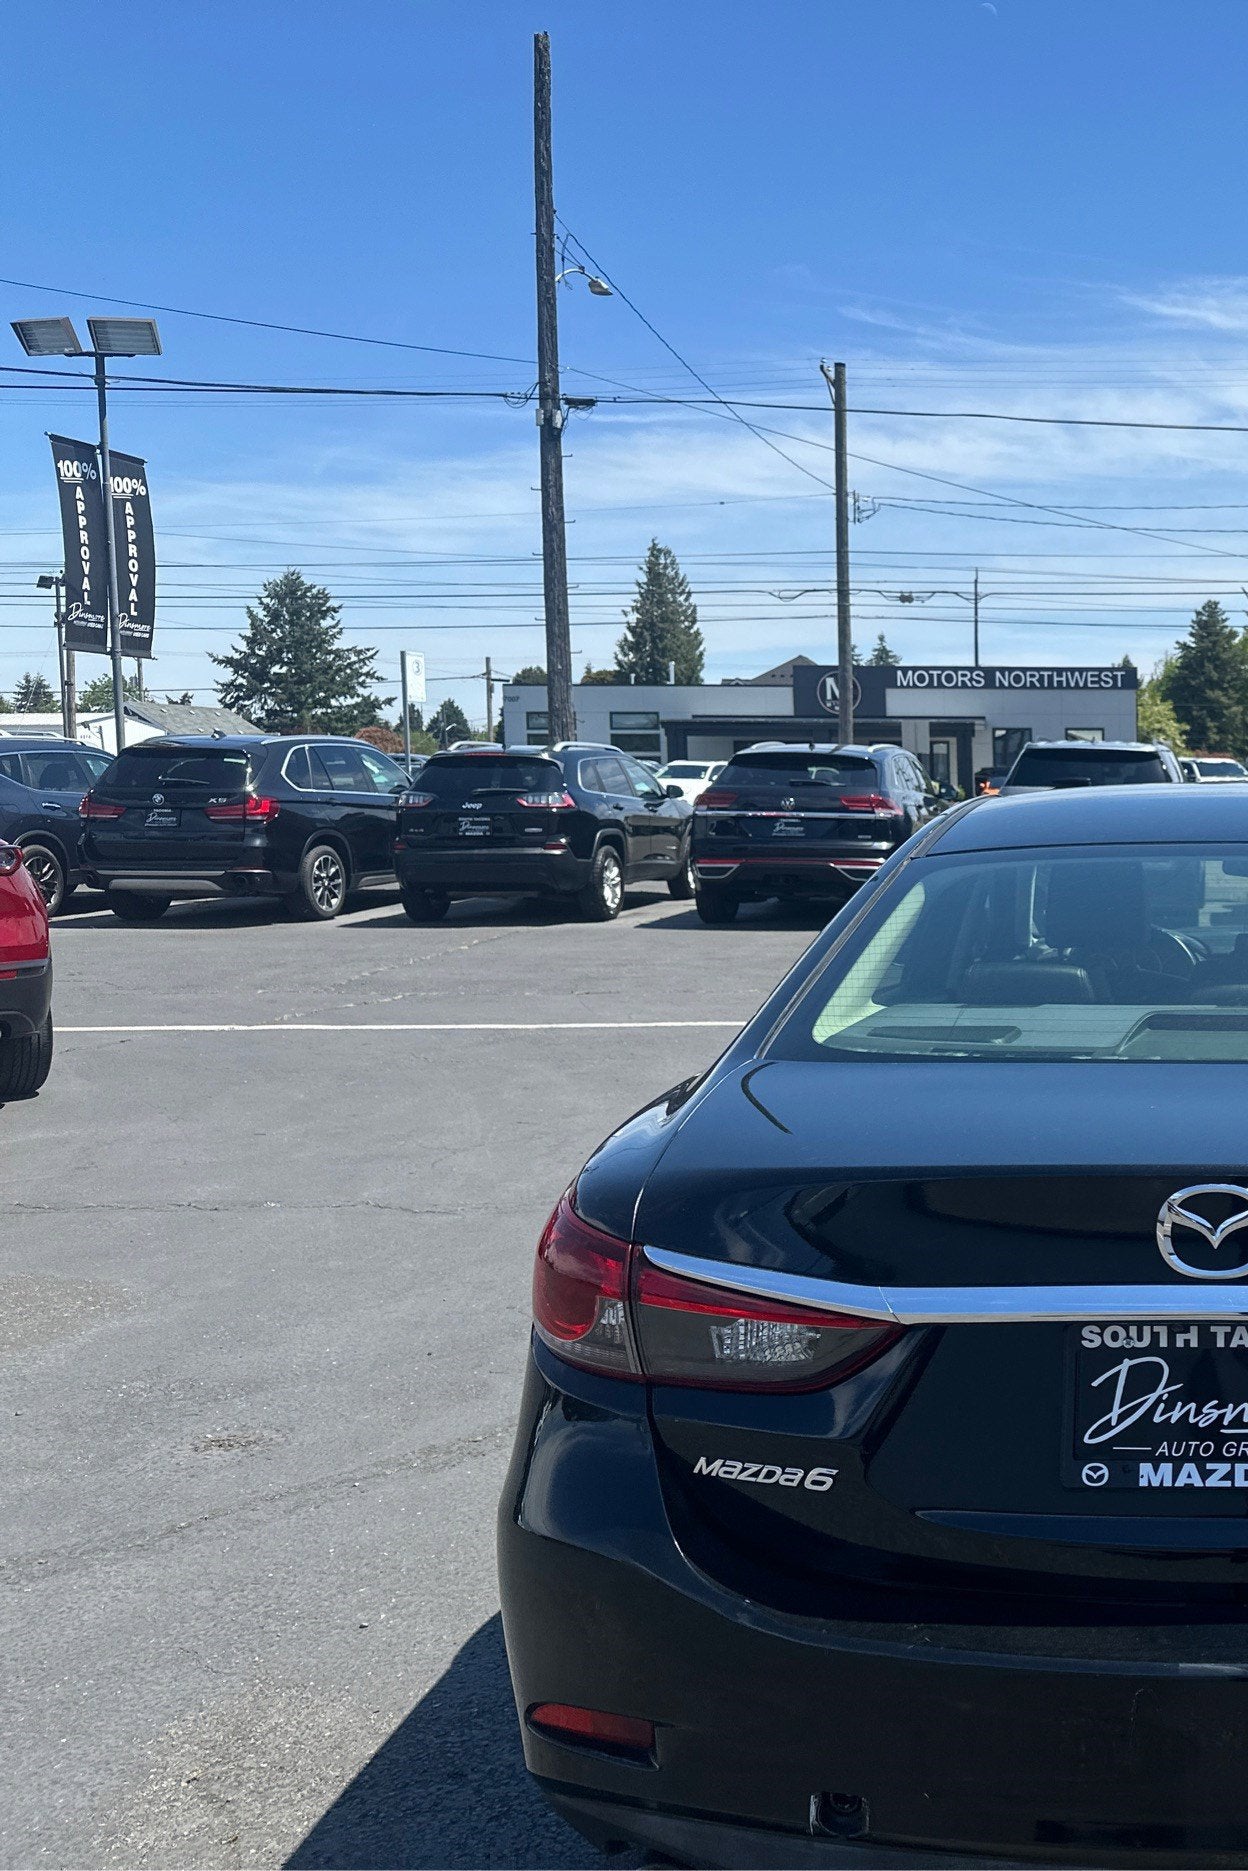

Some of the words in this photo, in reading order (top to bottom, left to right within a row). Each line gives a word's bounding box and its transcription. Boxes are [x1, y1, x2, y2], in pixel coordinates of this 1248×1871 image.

[57, 459, 97, 480] 100%
[109, 476, 147, 496] 100%
[75, 485, 91, 606] APPROVAL
[124, 501, 139, 617] APPROVAL
[896, 670, 985, 687] MOTORS
[995, 671, 1126, 688] NORTHWEST
[1081, 1325, 1198, 1349] SOUTH
[1155, 1441, 1216, 1457] AUTO
